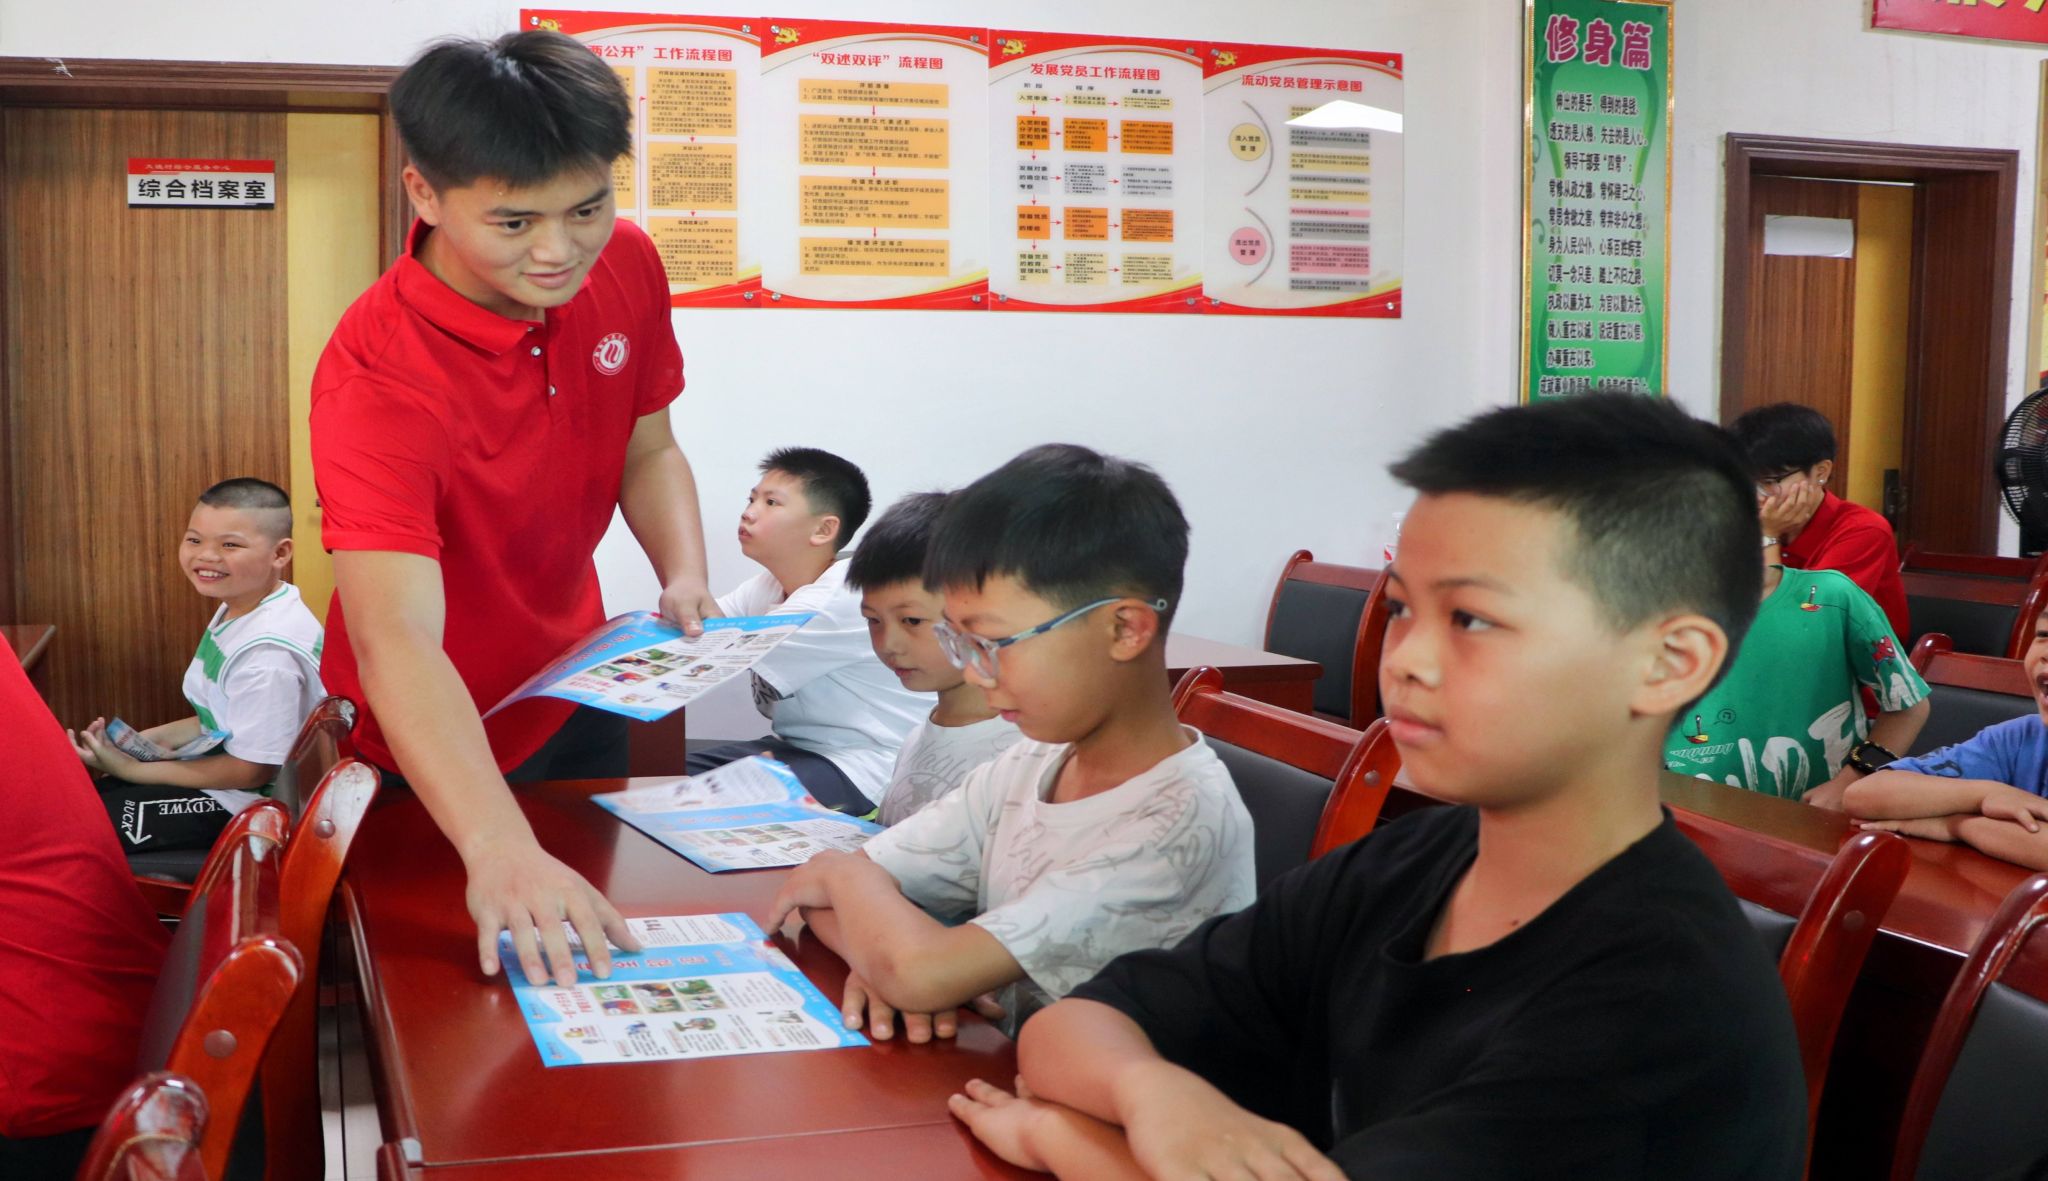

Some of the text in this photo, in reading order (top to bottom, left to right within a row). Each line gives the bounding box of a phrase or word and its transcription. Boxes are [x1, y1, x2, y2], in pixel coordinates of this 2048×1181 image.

[1546, 15, 1652, 70] 修身篇
[1030, 62, 1160, 81] 发展党员工作流程图
[1241, 74, 1363, 92] 流动党员管理示意图
[138, 178, 266, 200] 综合档案室
[121, 799, 136, 832] BUCK
